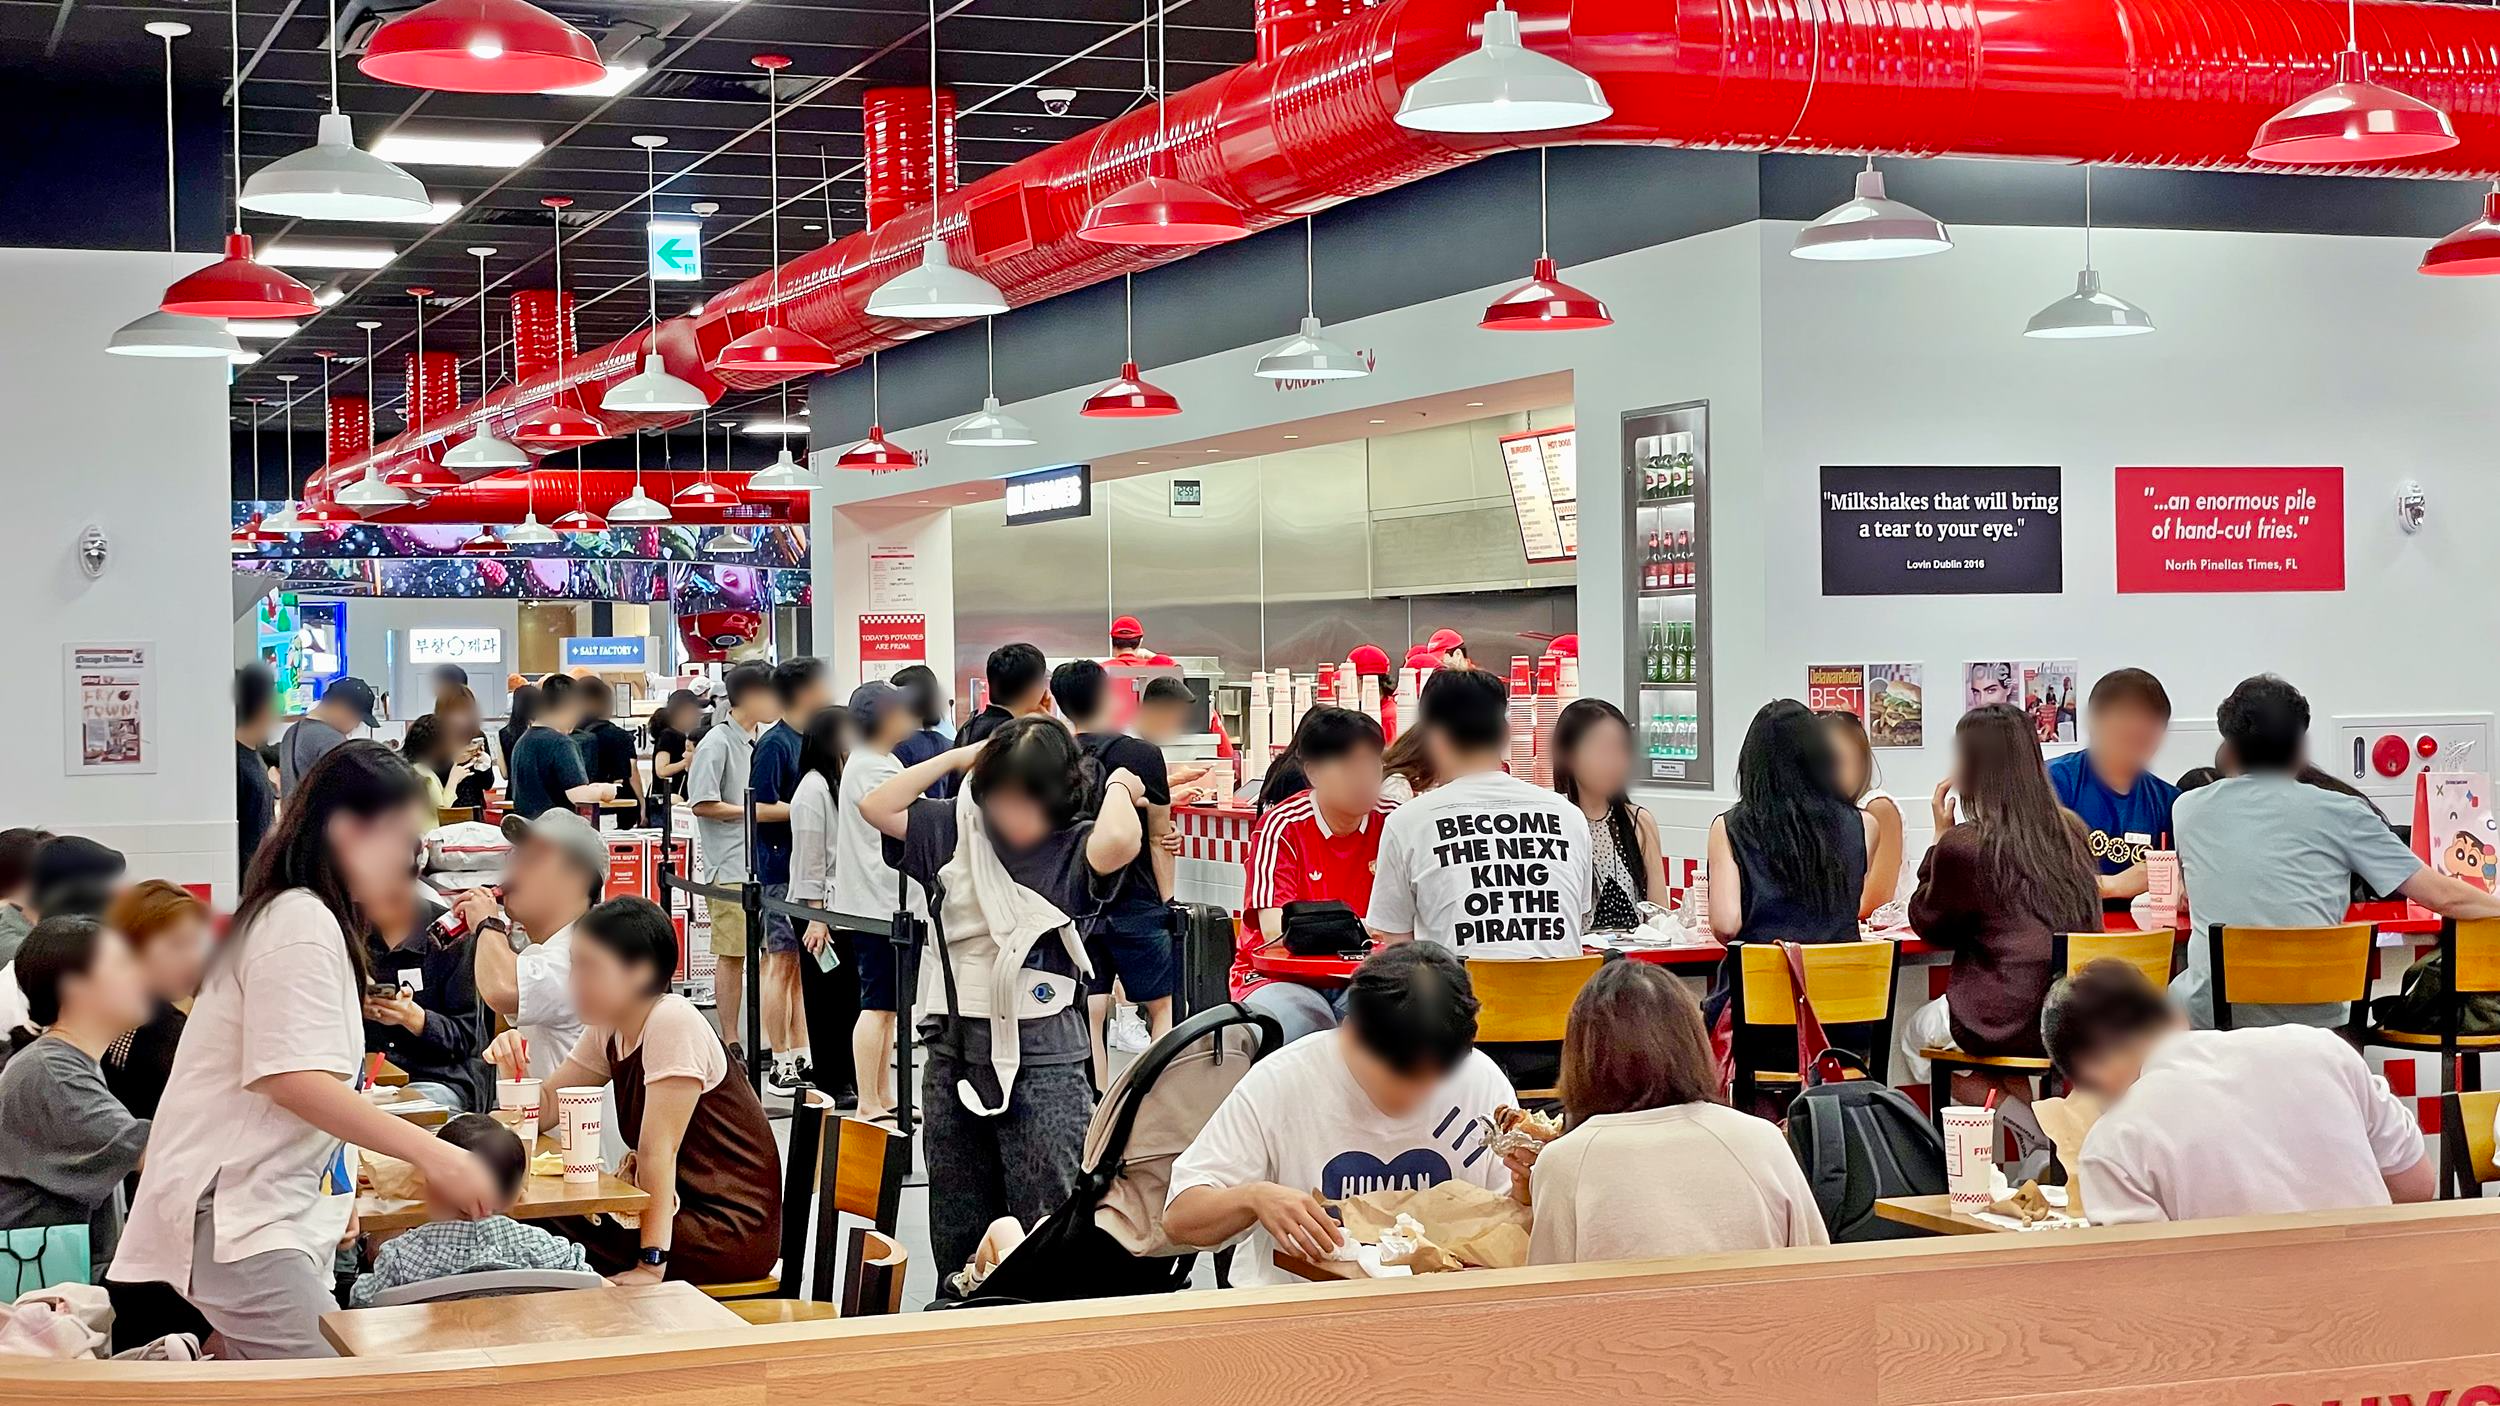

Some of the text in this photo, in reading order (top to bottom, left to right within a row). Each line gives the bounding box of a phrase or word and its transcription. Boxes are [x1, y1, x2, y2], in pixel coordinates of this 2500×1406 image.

[1823, 491, 2059, 514] "Milkshakes that will bring
[2196, 494, 2280, 510] enormous
[2285, 488, 2317, 514] pile
[1859, 517, 2026, 542] a tear to your eye."
[2151, 515, 2309, 540] of hand-cut fries."
[1906, 559, 1985, 570] Lovin Dublin 2016
[2165, 558, 2298, 572] North Pinellas Times, FL
[890, 633, 924, 641] POTATOES
[580, 645, 632, 656] SALT FACTORY
[1809, 687, 1863, 709] BEST
[1435, 812, 1562, 841] BECOME
[1433, 837, 1570, 868] THE NEXT
[1471, 863, 1549, 889] KING
[1464, 890, 1559, 917] OF THE
[1454, 917, 1566, 947] PIRATES
